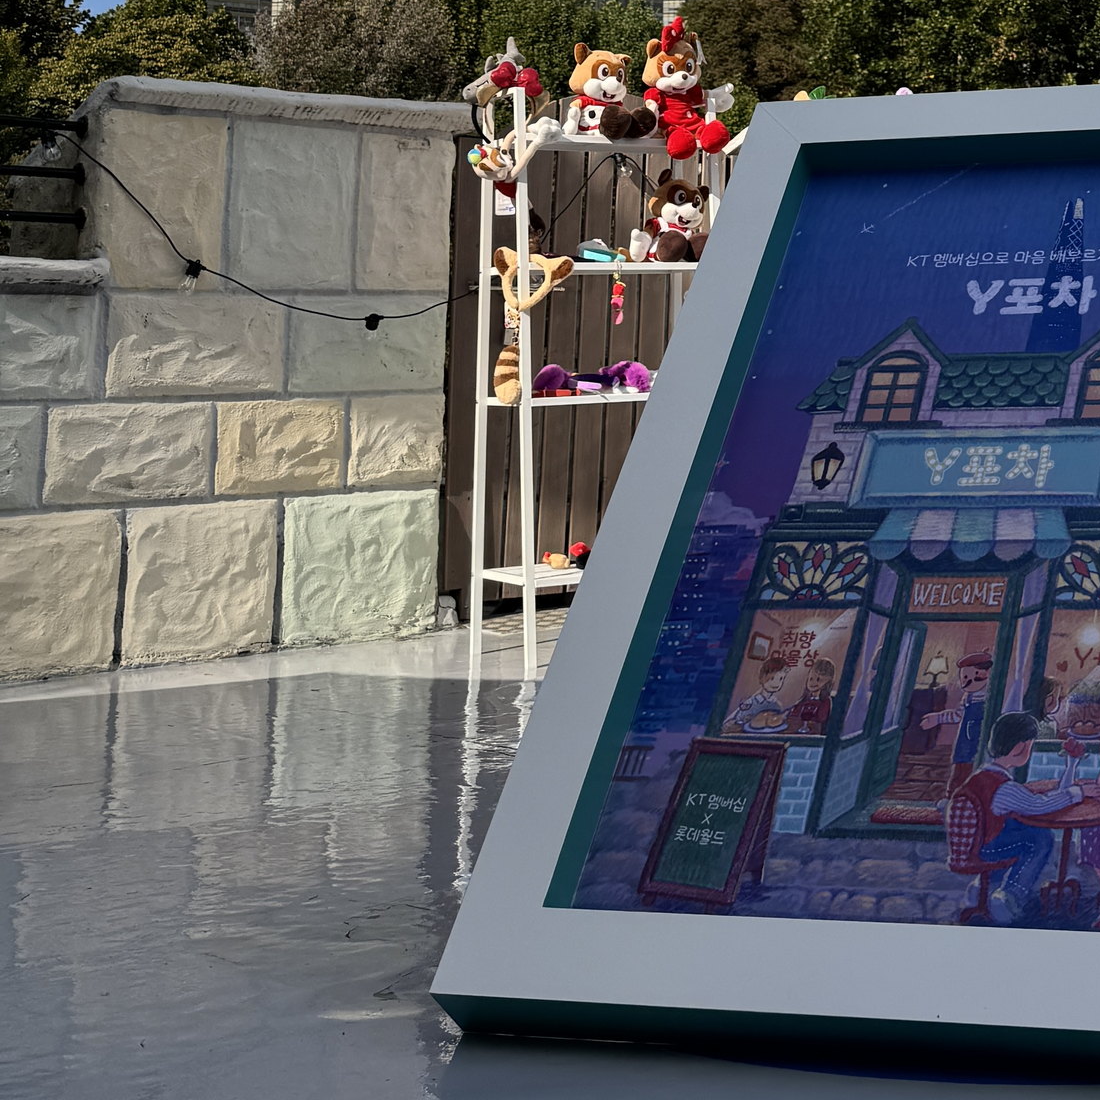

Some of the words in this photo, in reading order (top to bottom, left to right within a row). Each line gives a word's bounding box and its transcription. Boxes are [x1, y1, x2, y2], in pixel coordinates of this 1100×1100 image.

[906, 254, 932, 267] KT
[933, 251, 1009, 268] 멤버십으로
[1013, 250, 1046, 265] 마음
[966, 275, 1098, 315] Y포차
[924, 443, 1055, 488] Y포차
[912, 581, 1005, 607] WELCOME
[783, 629, 817, 649] 취향
[685, 793, 708, 806] KT
[708, 794, 747, 813] 멤버십
[673, 825, 726, 846] 롯데월드
